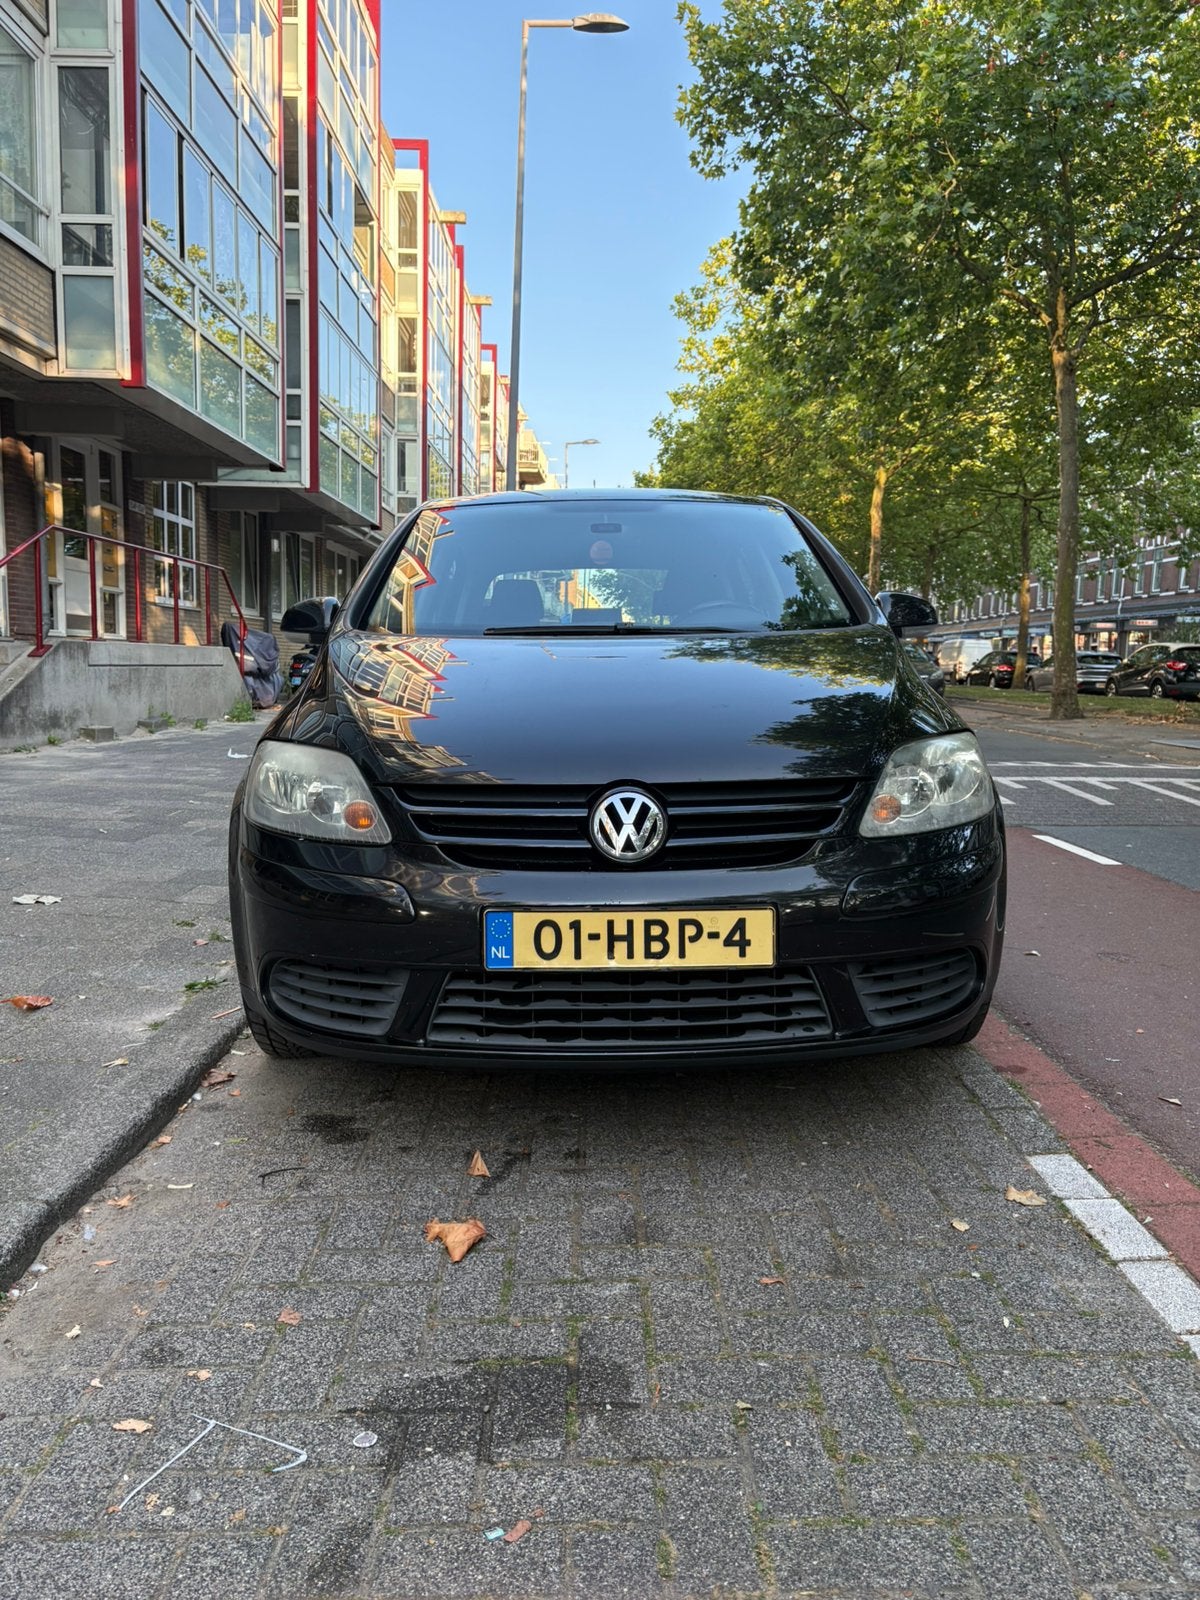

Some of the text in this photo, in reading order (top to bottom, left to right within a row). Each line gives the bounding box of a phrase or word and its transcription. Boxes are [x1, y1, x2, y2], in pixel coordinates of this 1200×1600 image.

[594, 793, 663, 858] VW
[491, 945, 510, 959] NL
[533, 917, 752, 961] 01-HBP-4
